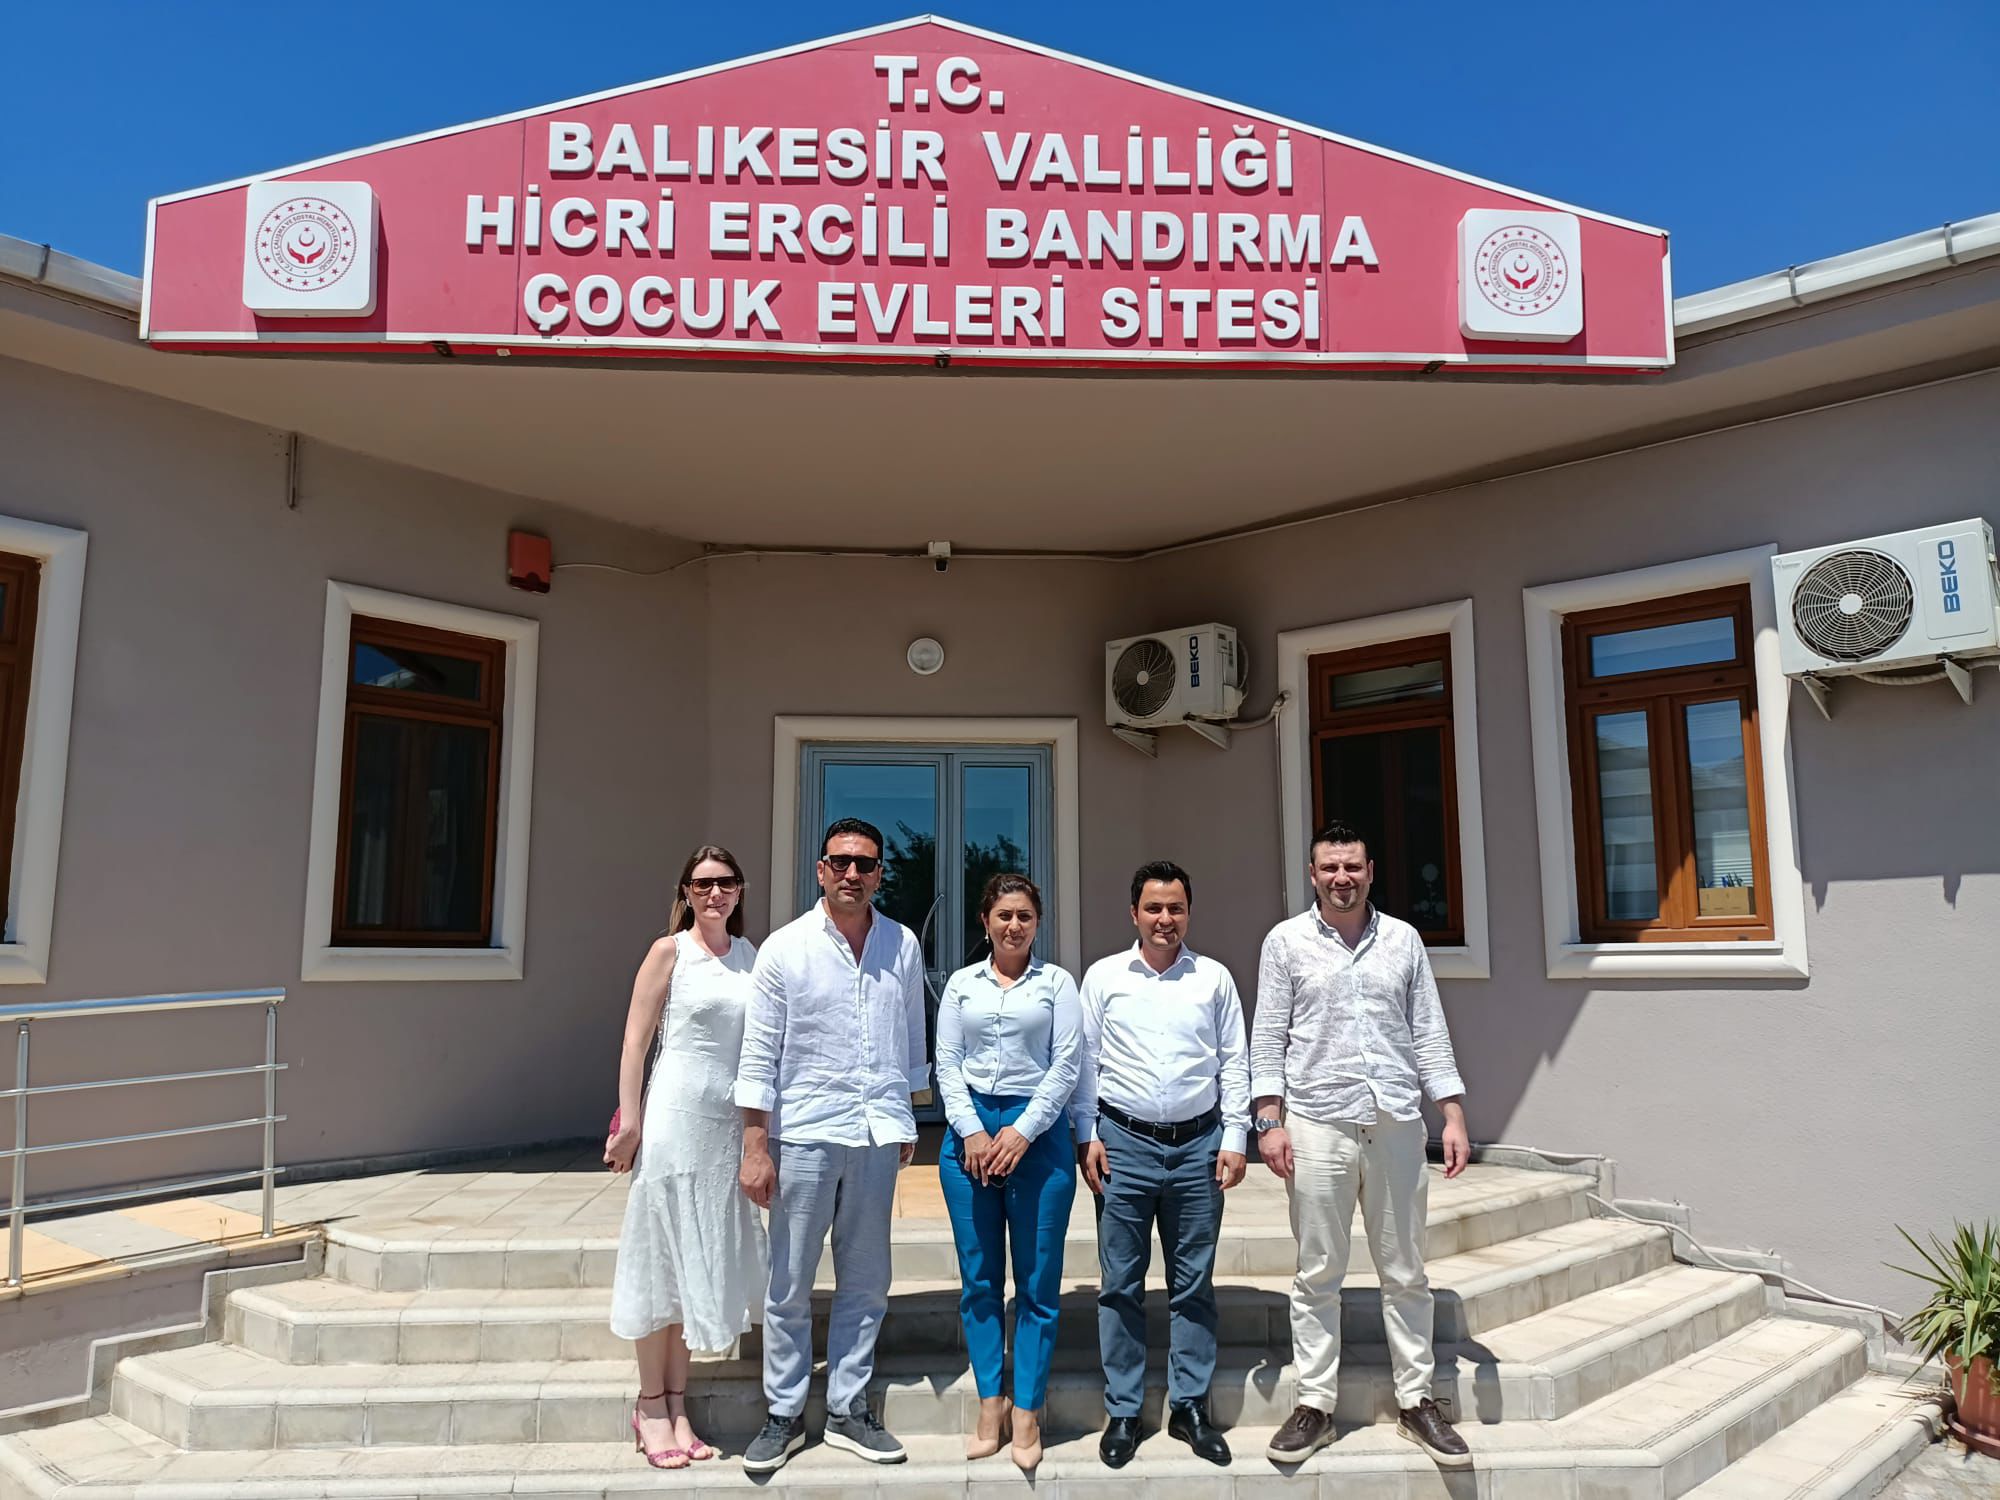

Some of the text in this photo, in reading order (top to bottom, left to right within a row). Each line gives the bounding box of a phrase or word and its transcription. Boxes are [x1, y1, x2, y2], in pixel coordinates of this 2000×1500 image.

[874, 55, 1004, 107] T.C.
[548, 119, 1294, 190] BALIKESİR VALİLİĞİ
[465, 184, 1380, 266] HİCRİ ERCİLİ BANDIRMA
[523, 273, 1320, 341] ÇOCUK EVLERİ SİTESİ
[1937, 540, 1961, 613] BEKO
[1189, 636, 1200, 688] BEKO
